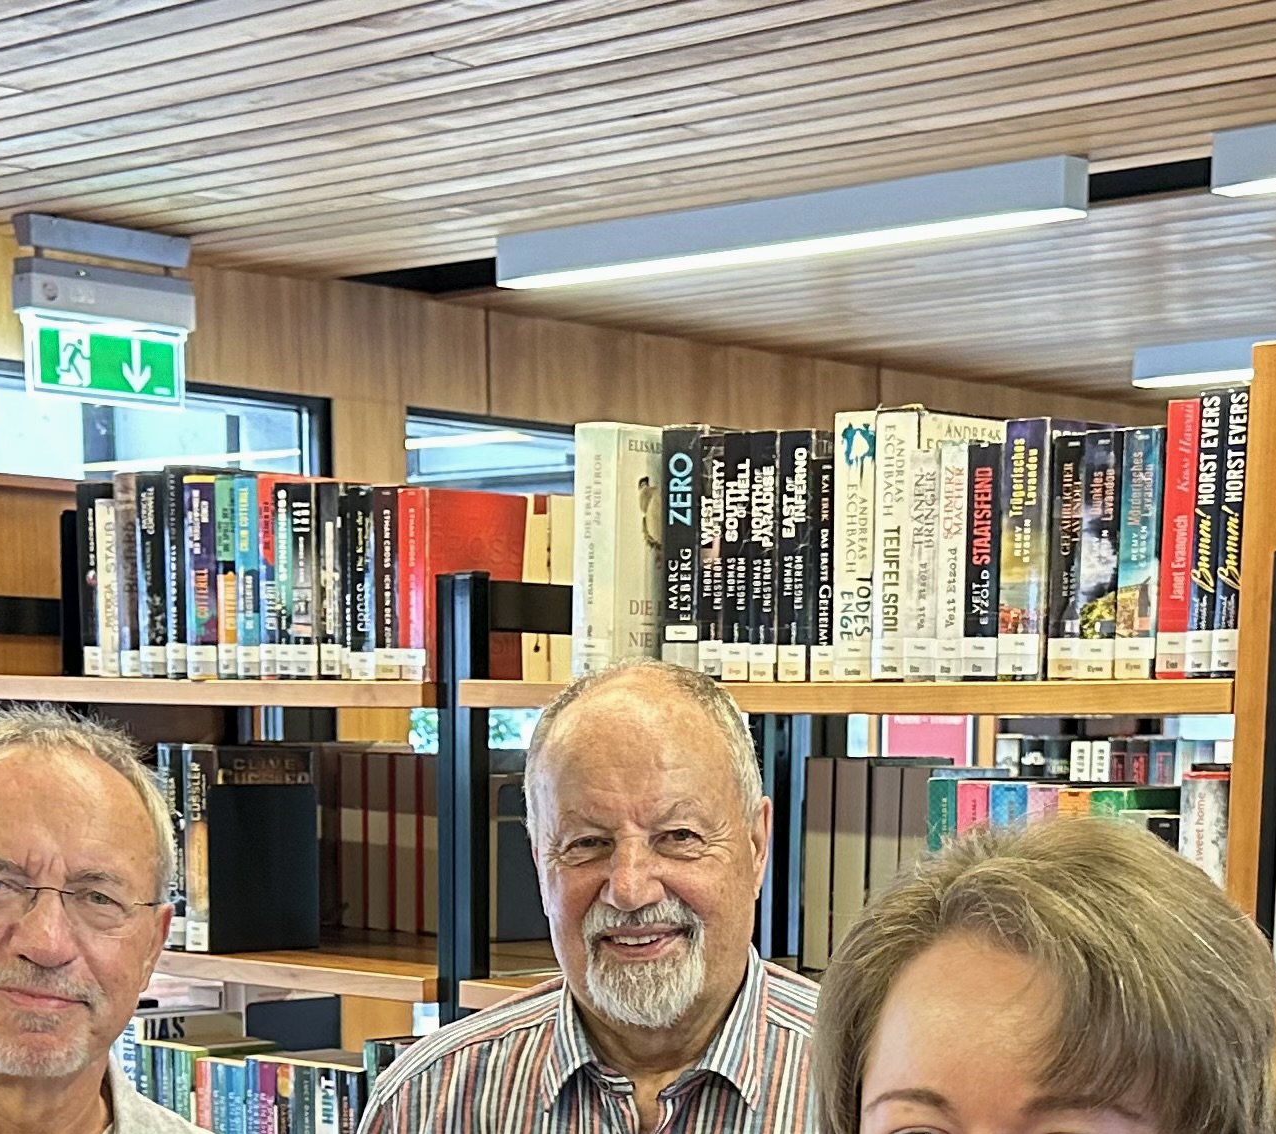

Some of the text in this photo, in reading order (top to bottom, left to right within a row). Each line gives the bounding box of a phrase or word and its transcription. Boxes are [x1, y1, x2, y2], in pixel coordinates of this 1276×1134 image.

[668, 452, 693, 527] ZERO
[711, 459, 725, 522] LIBERTY
[737, 457, 751, 502] HELL
[794, 447, 808, 523] INFERNO
[882, 424, 896, 517] ESCHBACH
[894, 438, 905, 503] ANDREAS
[1197, 451, 1218, 506] HORST
[1223, 447, 1245, 503] HORST
[700, 495, 713, 546] WEST
[725, 481, 739, 543] SOUTH
[751, 482, 764, 542] NORTH
[761, 464, 775, 548] PARADISE
[782, 494, 796, 538] EAST
[845, 483, 859, 574] ESCHBACH
[858, 495, 869, 561] ANDREAS
[923, 470, 938, 549] BRINGER
[972, 466, 994, 566] STAATSFEIND
[668, 560, 679, 610] MARC
[679, 547, 693, 621] ELSBERG
[703, 557, 713, 598] THOMAS
[726, 557, 736, 598] THOMAS
[752, 558, 762, 600] THOMAS
[783, 555, 794, 597] THOMAS
[944, 547, 958, 628] Veit Etzold
[1169, 515, 1189, 601] Janet Evanovich
[839, 589, 855, 641] ENGE
[854, 570, 873, 638] TODES
[971, 581, 981, 614] VEIT
[979, 569, 991, 625] ETZOLD
[190, 762, 201, 821] CUSSLER
[233, 757, 296, 771] CLIVE
[1194, 791, 1207, 826] home
